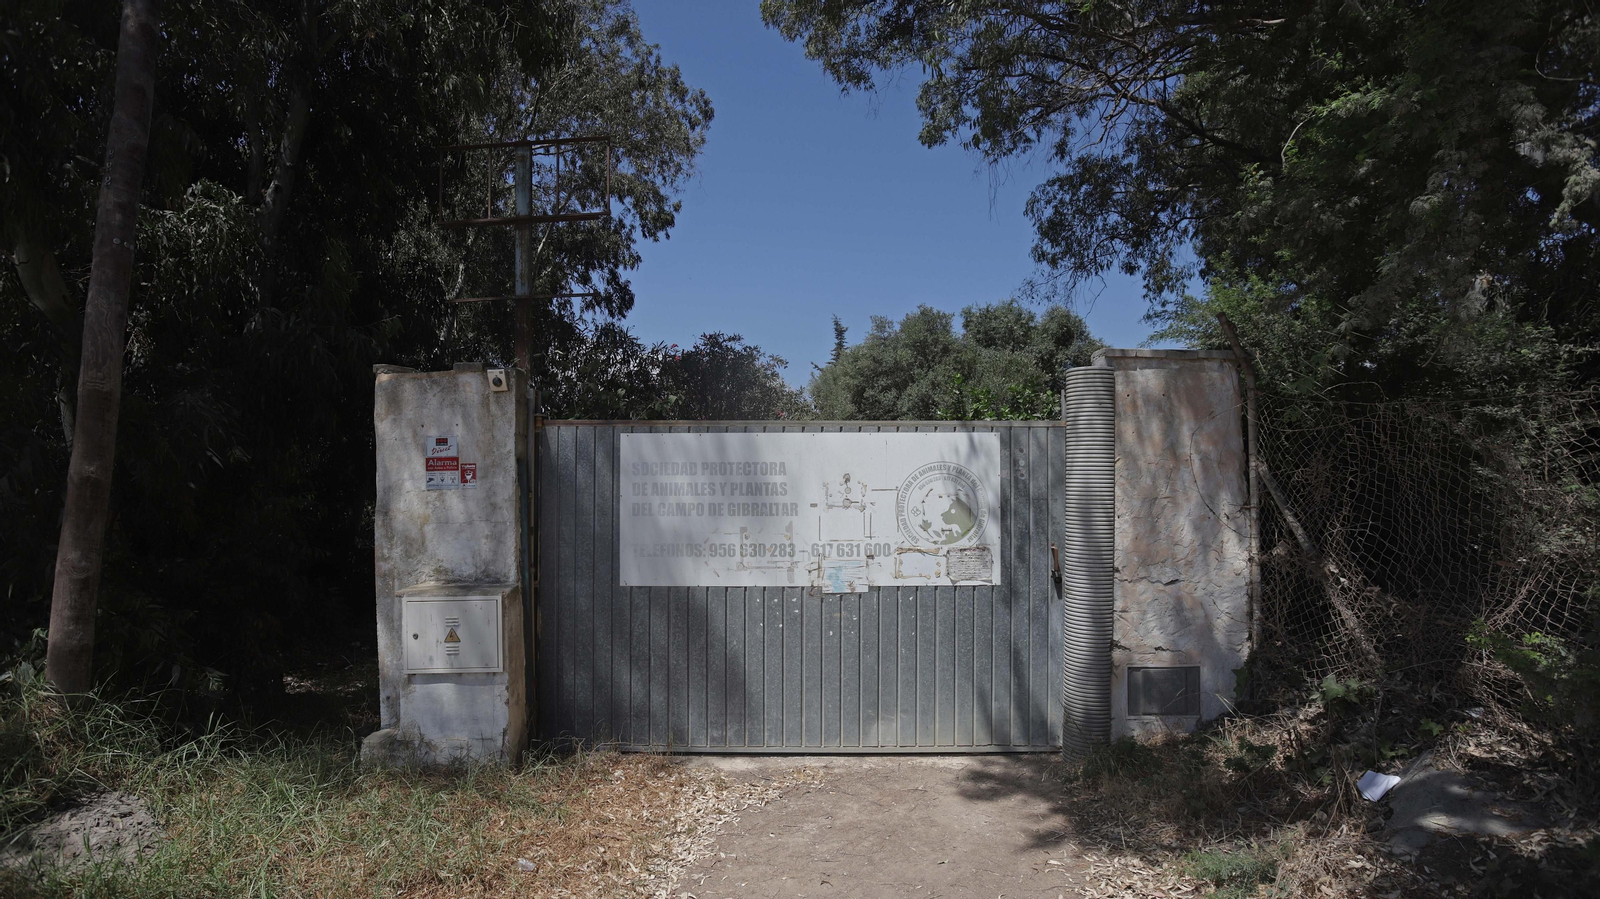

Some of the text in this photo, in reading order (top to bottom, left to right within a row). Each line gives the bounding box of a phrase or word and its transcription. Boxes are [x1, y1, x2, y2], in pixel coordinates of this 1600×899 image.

[631, 461, 787, 476] SOCIEDAD PROTECTORA
[918, 464, 947, 477] ANIMALES
[947, 464, 952, 472] Y
[912, 473, 920, 484] DE
[631, 482, 788, 497] DE ANIMALES Y PLANTAS
[898, 479, 914, 517] PROTECTORA
[631, 502, 799, 517] DEL CAMPO DE GIBRALTAR
[900, 518, 920, 544] SOCIEDAD
[709, 543, 737, 558] 956
[740, 543, 767, 558] 630
[769, 543, 797, 558] 283
[811, 543, 834, 558] 617
[836, 543, 861, 558] 631
[864, 543, 891, 558] 600
